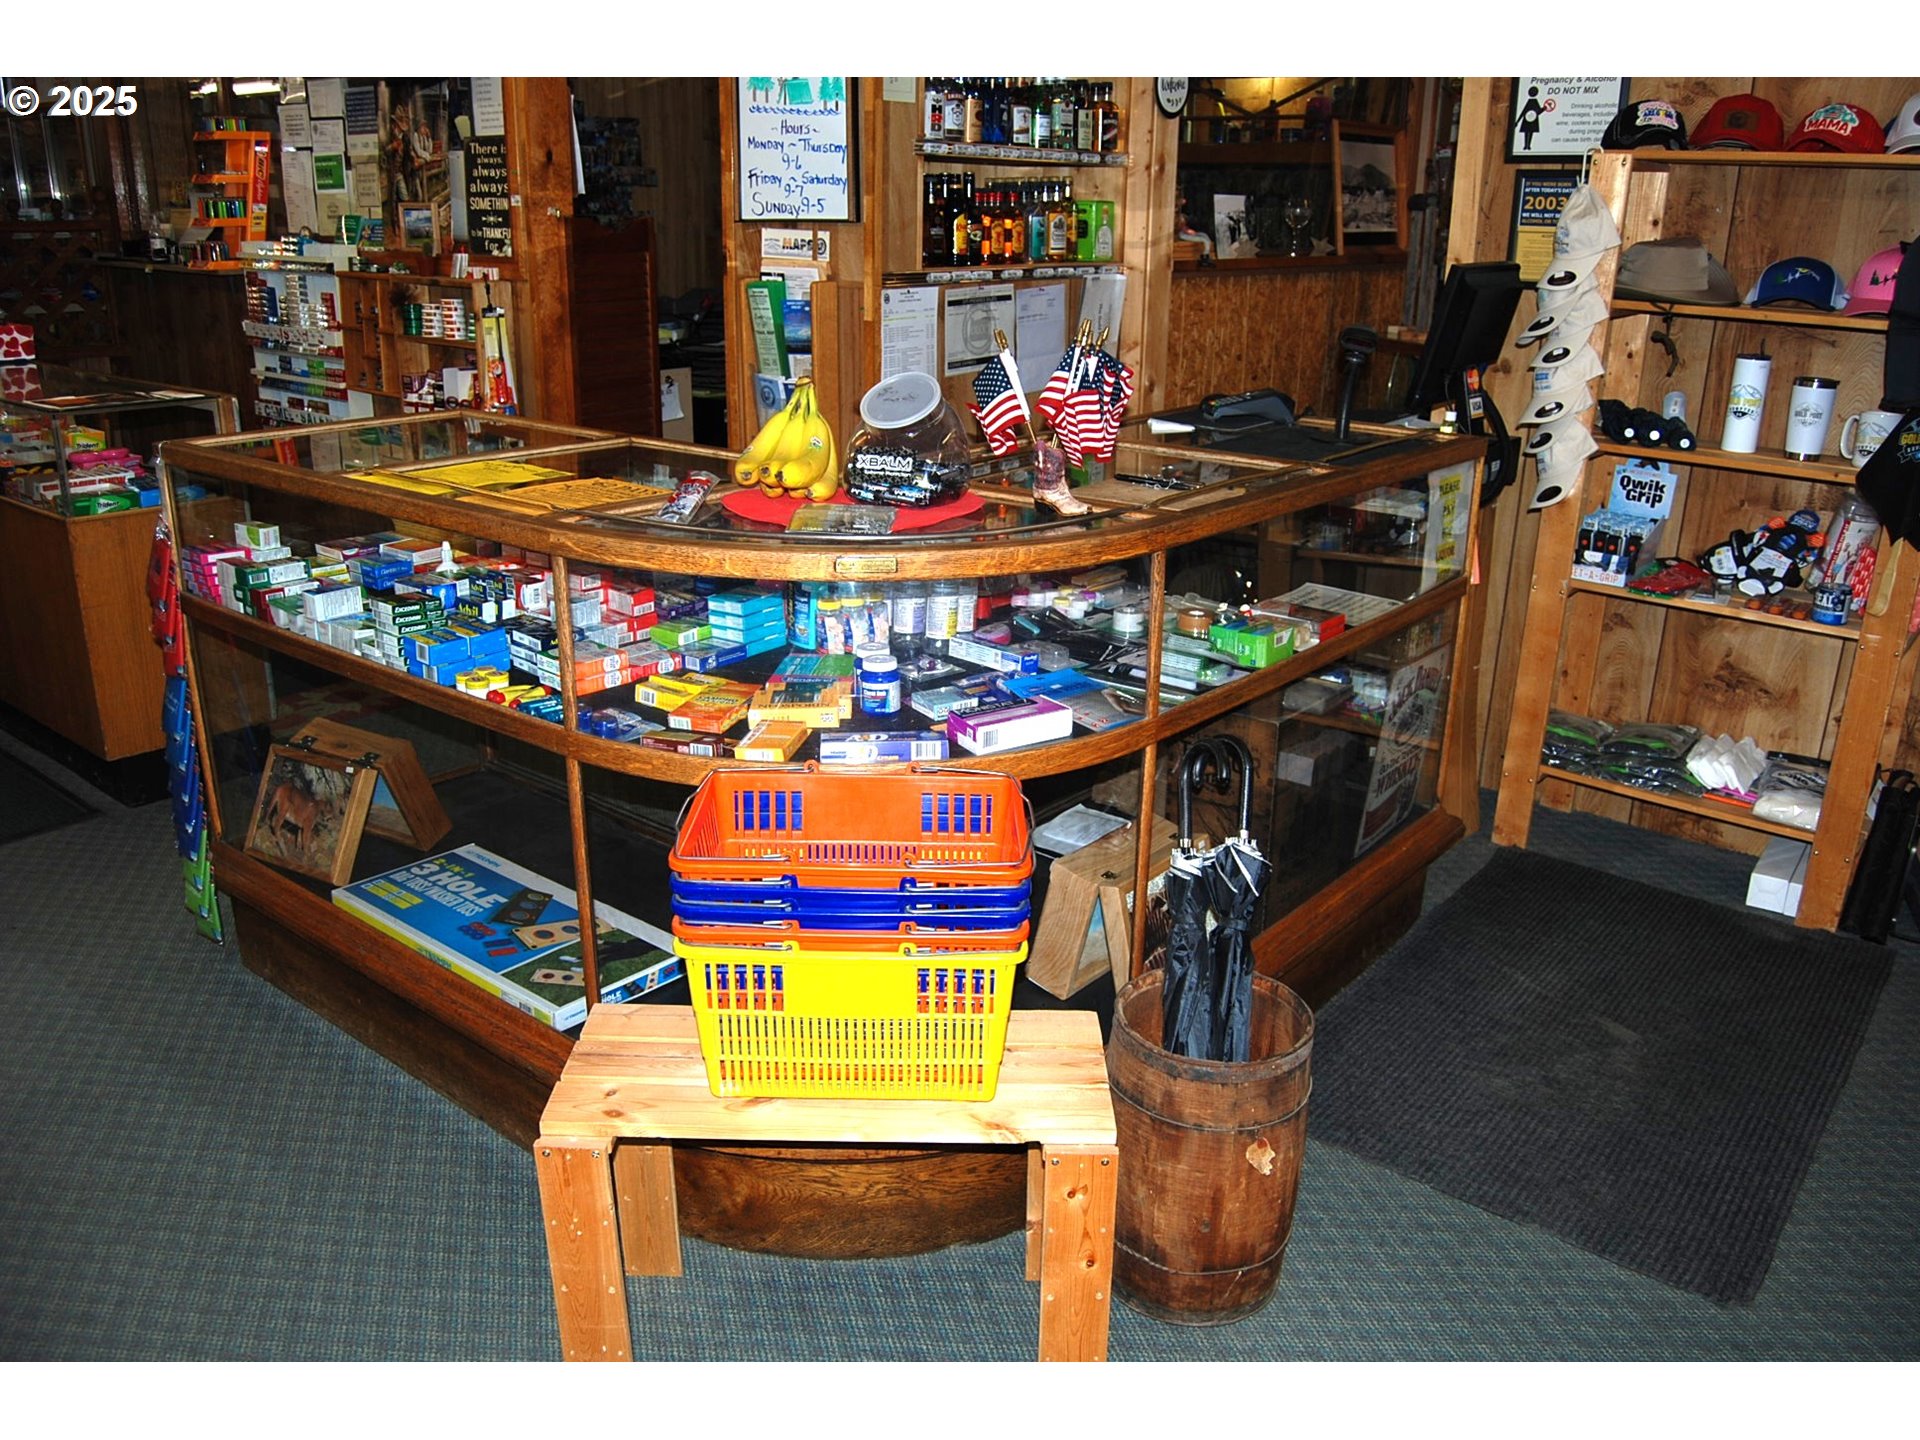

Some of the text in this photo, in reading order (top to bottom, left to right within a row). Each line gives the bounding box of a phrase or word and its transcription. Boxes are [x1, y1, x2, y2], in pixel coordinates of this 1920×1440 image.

[1547, 87, 1560, 95] DO
[1583, 86, 1599, 94] MIX
[1807, 119, 1849, 134] MAMA
[470, 143, 497, 154] There
[782, 152, 802, 171] 9-6
[784, 183, 804, 199] 9-7
[470, 197, 509, 211] SOMETHIN
[1524, 196, 1567, 210] 2003
[482, 227, 511, 239] THANKFU
[485, 240, 498, 251] for
[76, 442, 100, 450] Trident
[858, 454, 912, 471] XBALM
[1620, 475, 1666, 495] Qwik
[97, 500, 120, 509] Trident
[1625, 488, 1664, 509] Grip
[1573, 567, 1619, 584] ET-A-GRIP
[458, 602, 479, 616] Advil
[410, 862, 440, 876] 3
[429, 873, 509, 909] HOLE
